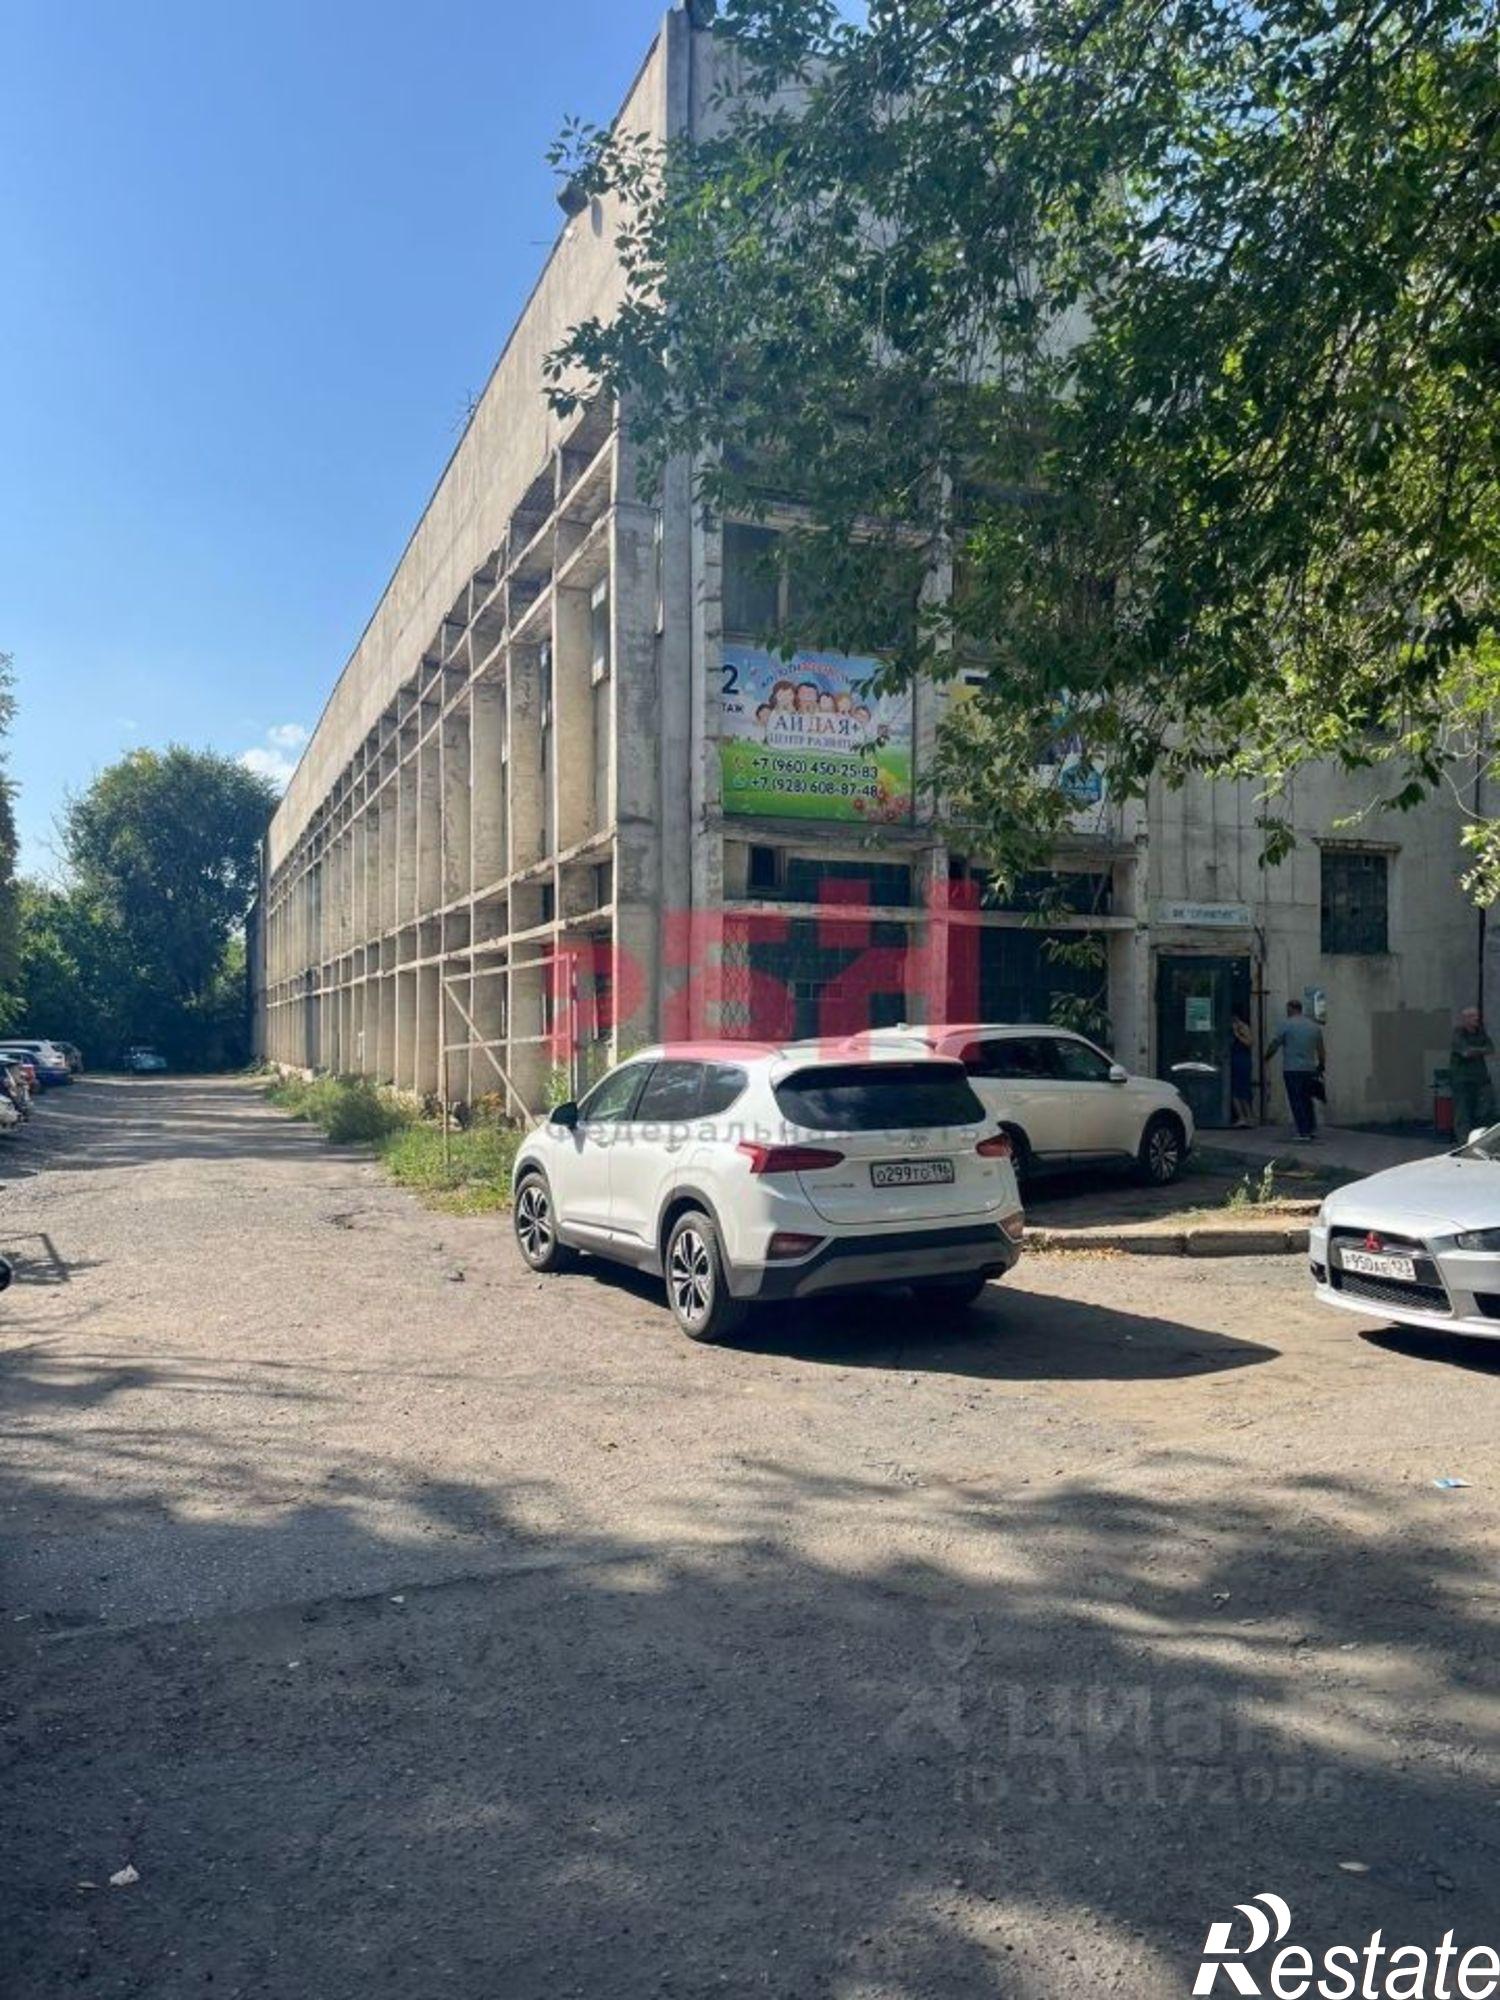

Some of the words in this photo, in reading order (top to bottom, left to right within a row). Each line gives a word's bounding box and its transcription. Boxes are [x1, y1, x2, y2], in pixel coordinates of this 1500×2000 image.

[722, 663, 740, 696] 2
[720, 702, 745, 714] ТАЖ
[752, 757, 769, 770] +7
[772, 759, 807, 775] (960)
[752, 777, 769, 789] +7
